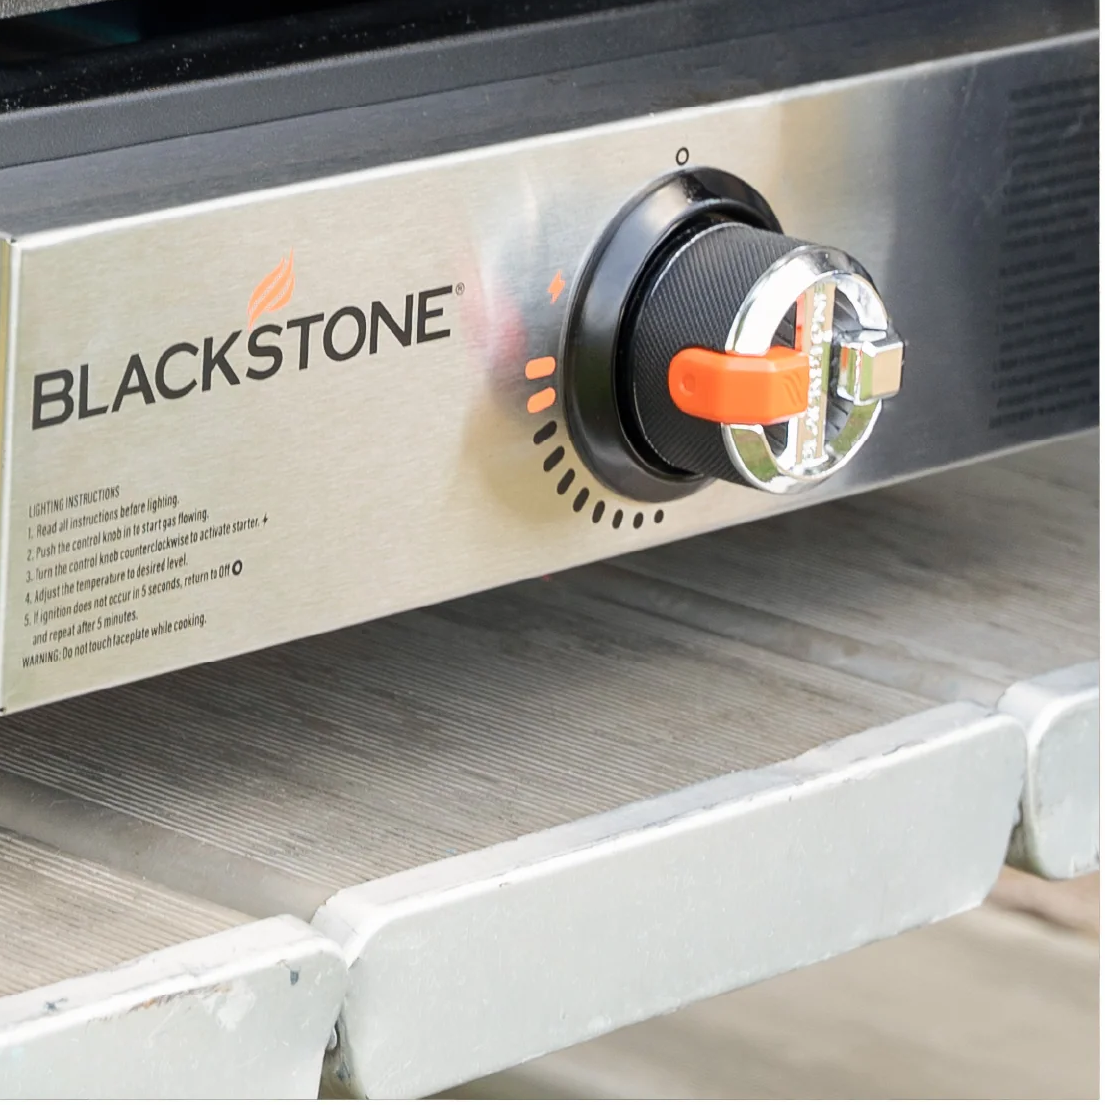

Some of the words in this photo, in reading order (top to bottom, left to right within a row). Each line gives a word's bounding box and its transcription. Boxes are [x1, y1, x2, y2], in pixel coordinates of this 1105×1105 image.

[28, 498, 64, 519] LIGHTING
[65, 485, 120, 509] INSTRUCTIONS
[36, 521, 57, 538] Read
[59, 517, 69, 532] all
[70, 509, 118, 529] instructions
[120, 502, 146, 519] before
[147, 494, 180, 513] lighting.
[27, 549, 34, 562] 2.
[36, 543, 56, 559] Push
[58, 540, 71, 554] the
[72, 532, 101, 551] control
[102, 528, 122, 544] knob
[123, 525, 132, 538] in
[133, 524, 140, 535] to
[142, 519, 162, 533] start
[163, 515, 177, 532] gas
[178, 508, 209, 525] flowing.
[35, 567, 53, 581] Turn
[55, 562, 68, 576] the
[68, 555, 97, 573] control
[99, 550, 119, 566] knob
[120, 533, 189, 560] counterclockwise
[190, 531, 198, 544] to
[199, 522, 231, 541] activate
[232, 517, 260, 533] starter.
[35, 585, 60, 603] Adjust
[62, 582, 75, 596] the
[76, 572, 125, 593] temperature
[127, 568, 135, 580] to
[136, 558, 166, 578] desired
[167, 552, 188, 571] level.
[40, 606, 72, 625] ignition
[73, 600, 92, 615] does
[94, 595, 108, 609] not
[109, 590, 132, 606] occur
[132, 586, 140, 600] in
[141, 584, 147, 598] 5
[184, 572, 209, 587] return
[210, 568, 218, 580] to
[218, 562, 231, 578] Off
[22, 649, 62, 669] WARNING:
[62, 646, 73, 659] Do
[74, 641, 88, 656] not
[89, 637, 112, 653] touch
[112, 628, 150, 647] faceplate
[150, 620, 173, 637] while
[173, 613, 207, 632] cooking.
[32, 630, 48, 646] and
[49, 624, 75, 642] repeat
[76, 620, 96, 636] after
[97, 616, 103, 630] 5
[104, 610, 139, 629] minutes.
